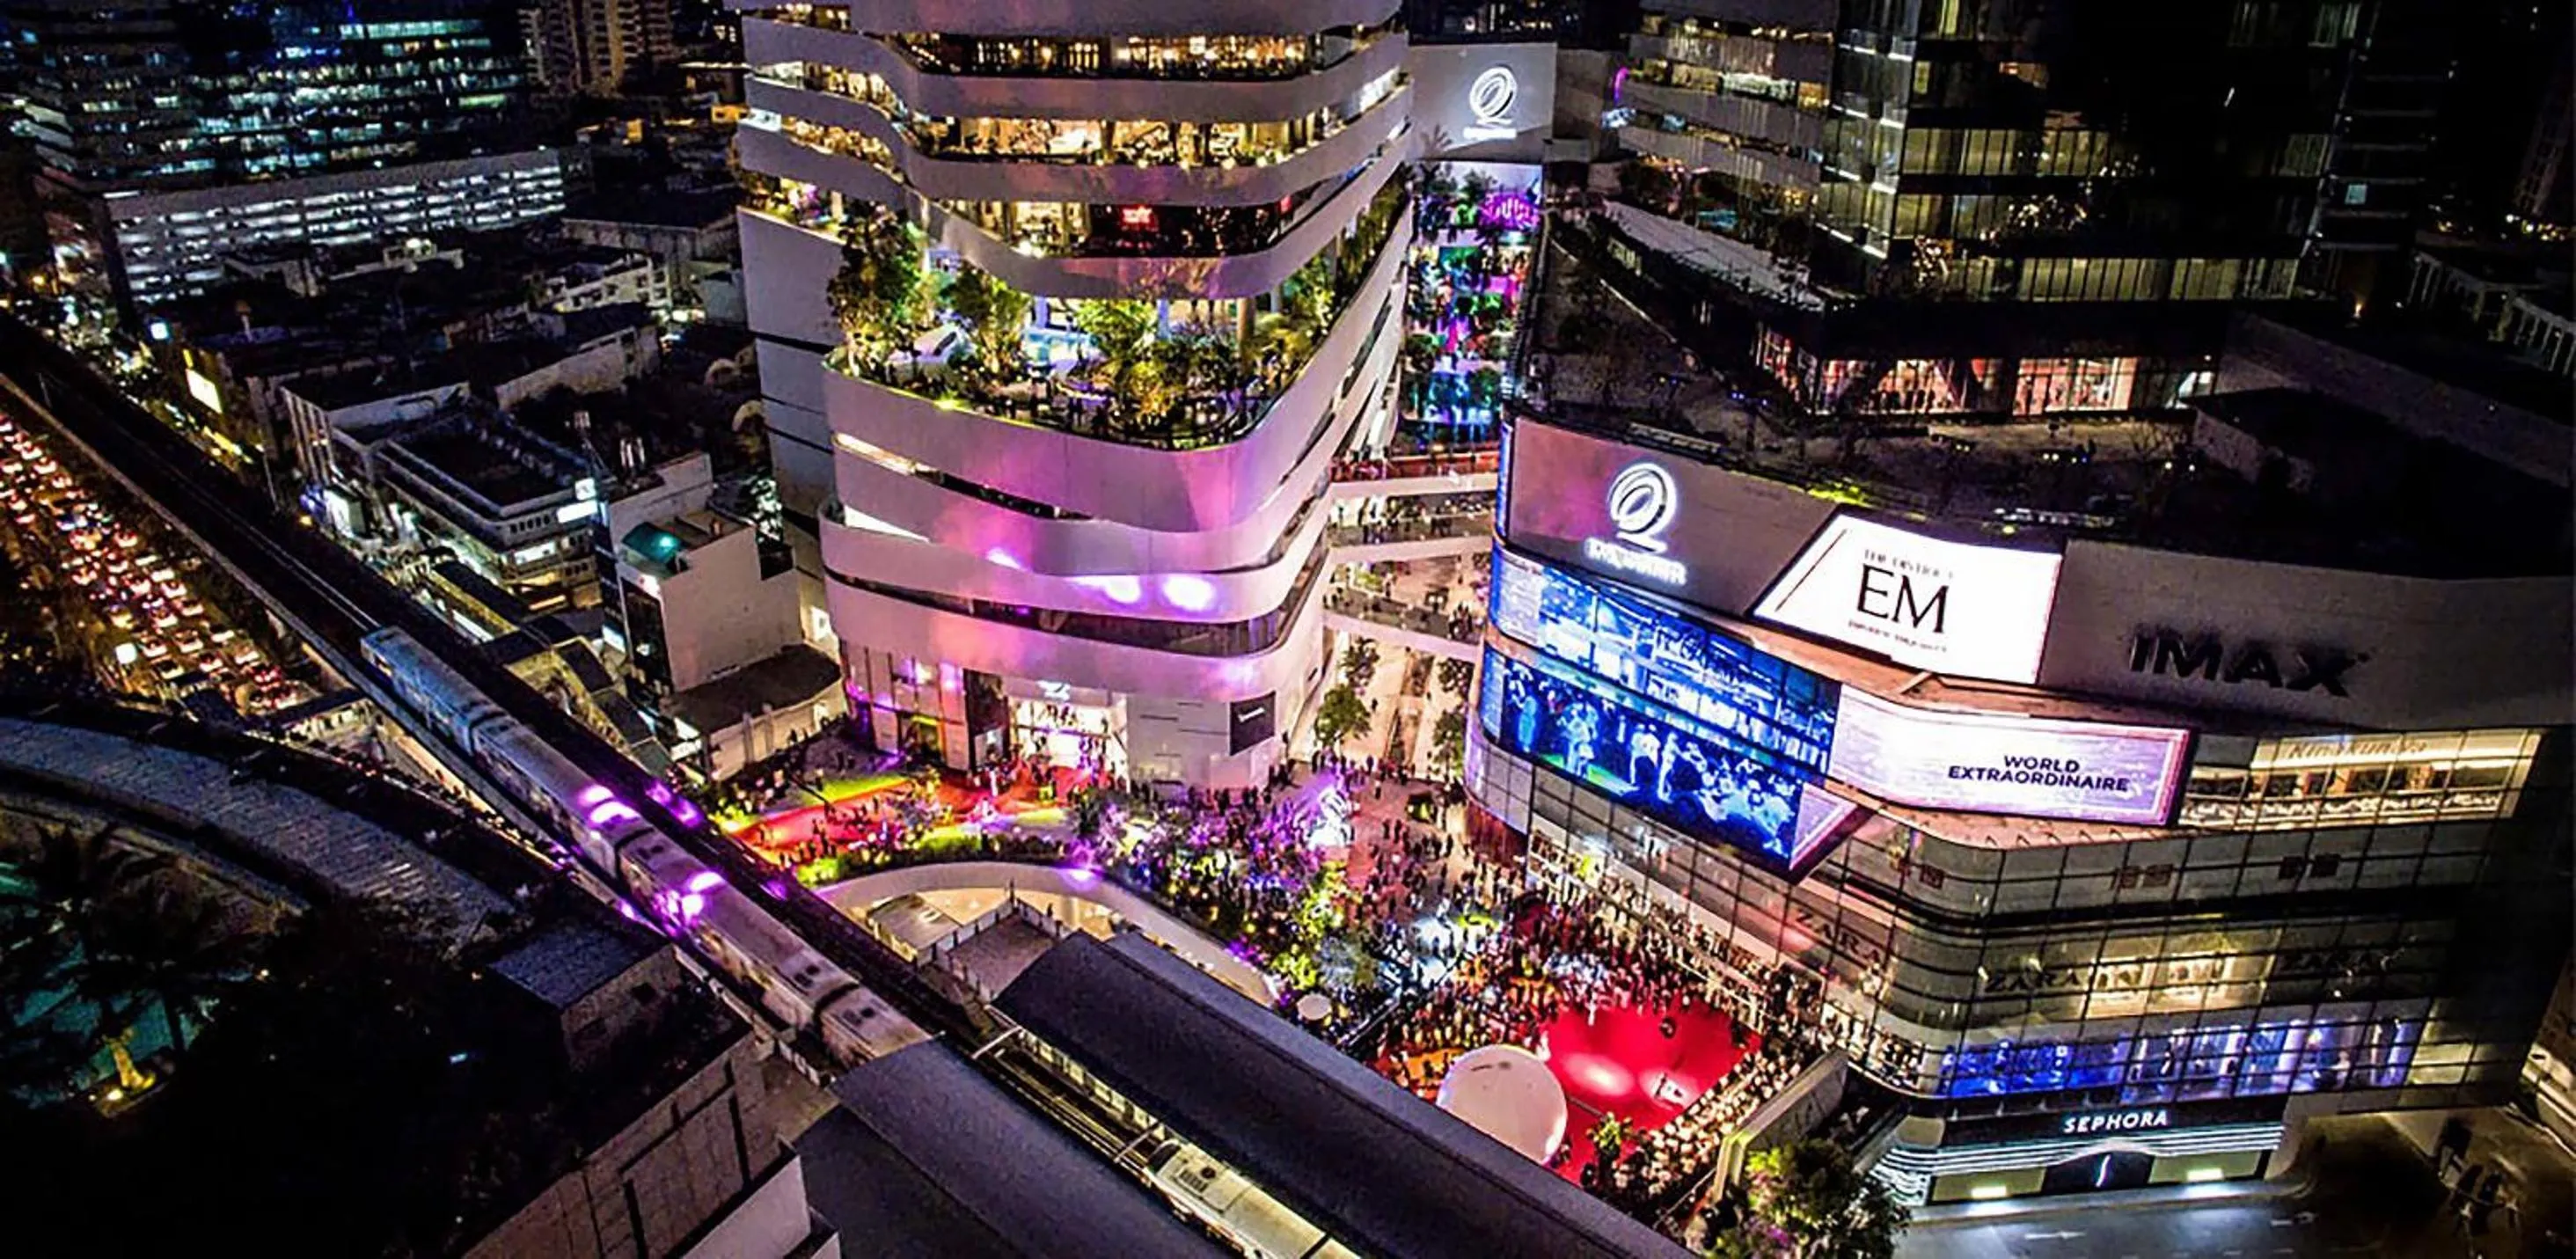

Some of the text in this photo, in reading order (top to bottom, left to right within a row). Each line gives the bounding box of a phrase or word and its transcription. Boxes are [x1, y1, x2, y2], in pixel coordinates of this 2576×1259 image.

[1856, 563, 1950, 634] EM
[2128, 628, 2358, 698] IMAX
[2003, 754, 2081, 773] WORLD
[1947, 765, 2130, 793] EXTRAORDINAIRE
[1796, 907, 1882, 965] ZARA
[1985, 971, 2081, 992] ZARA
[2062, 1109, 2168, 1134] SEPHORA
